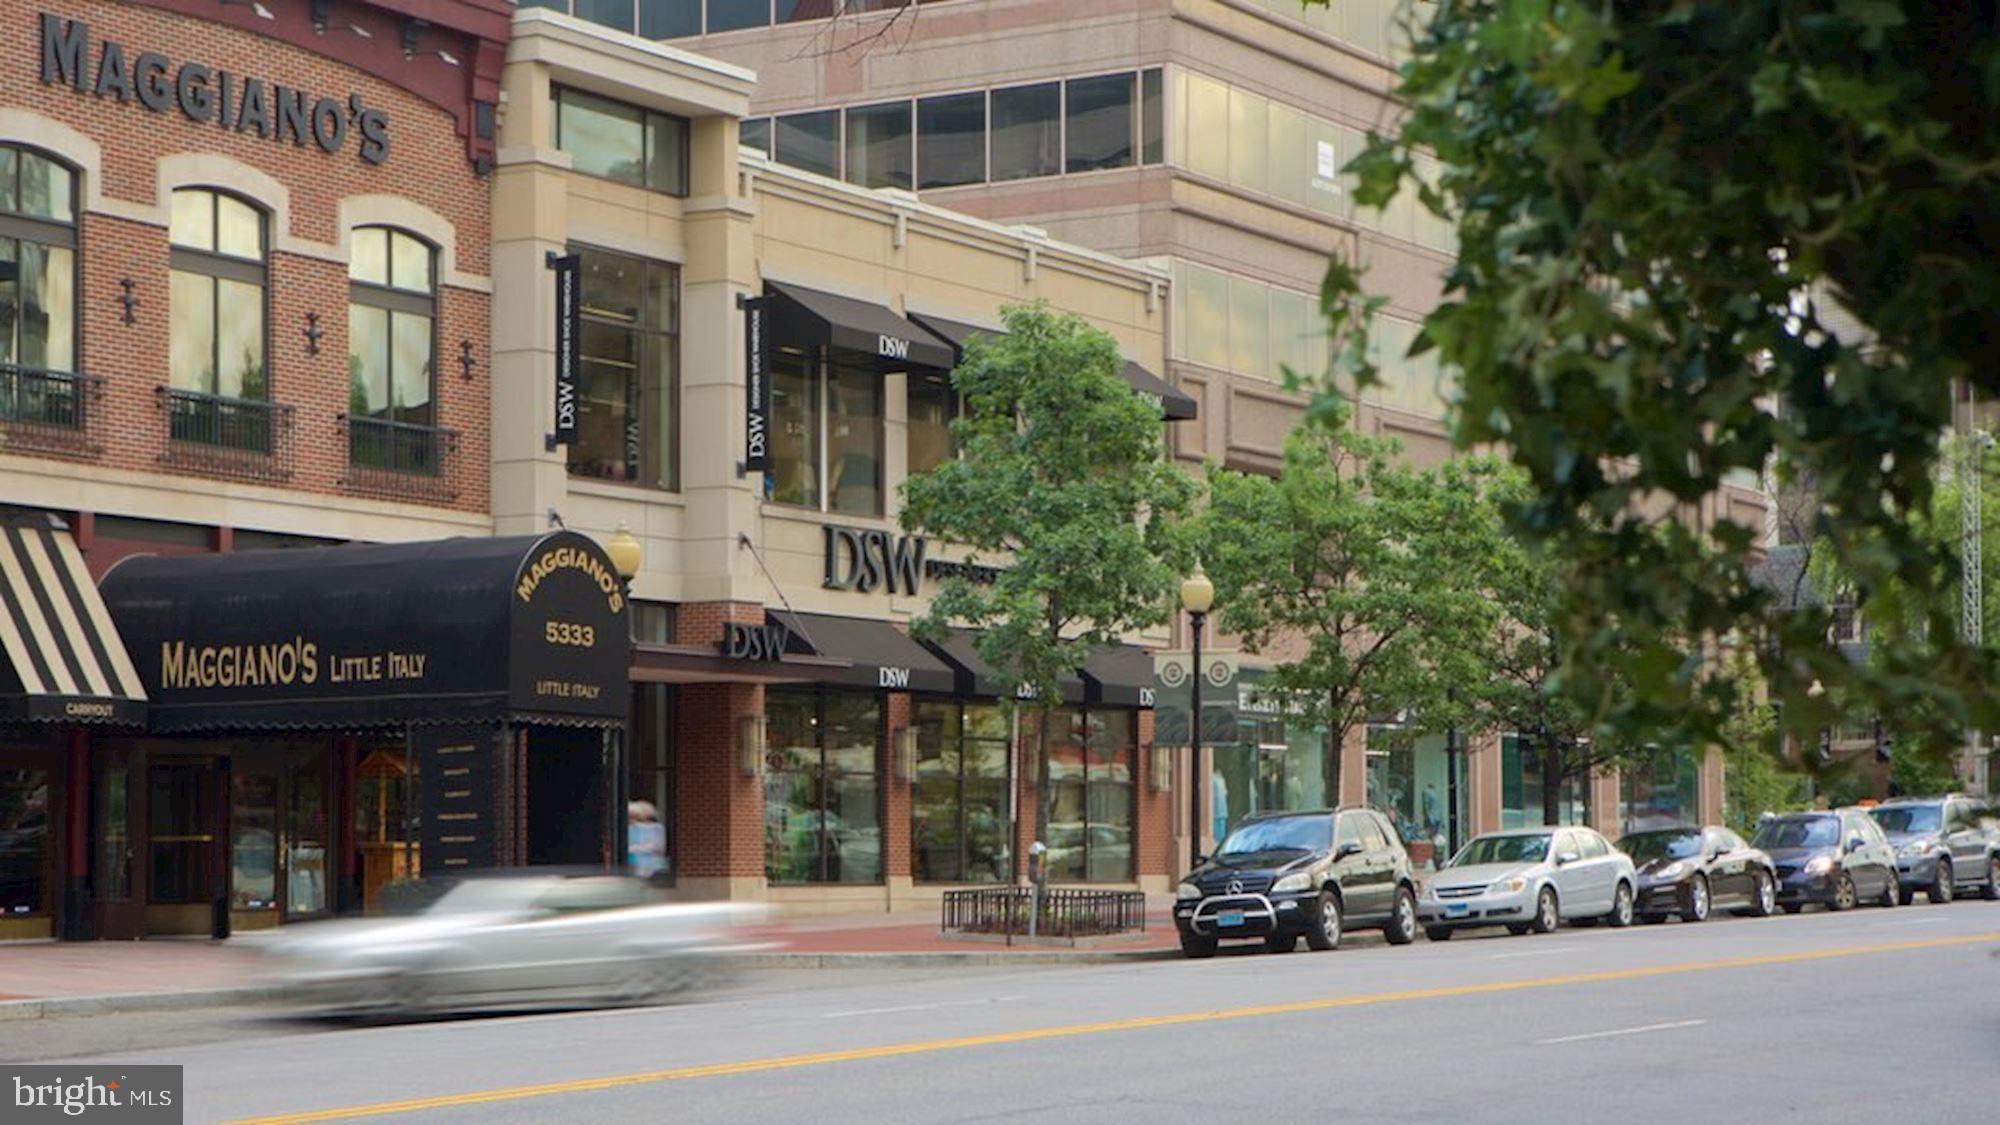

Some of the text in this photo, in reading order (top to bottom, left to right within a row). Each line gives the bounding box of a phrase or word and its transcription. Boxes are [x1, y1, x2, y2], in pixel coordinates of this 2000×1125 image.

[39, 12, 390, 166] MAGGIANO'S
[879, 334, 910, 359] DSW
[558, 381, 575, 430] DSW
[749, 412, 765, 458] DSW
[516, 547, 624, 614] MAGGIANO'S
[822, 523, 927, 596] DSW
[545, 621, 595, 648] 5333
[723, 621, 790, 663] DSW
[160, 635, 426, 689] MAGGIANO'S LITTLE ITALY
[878, 666, 910, 688] DSW
[64, 702, 114, 717] CARRYOUT
[535, 681, 601, 699] LITTLE ITALY
